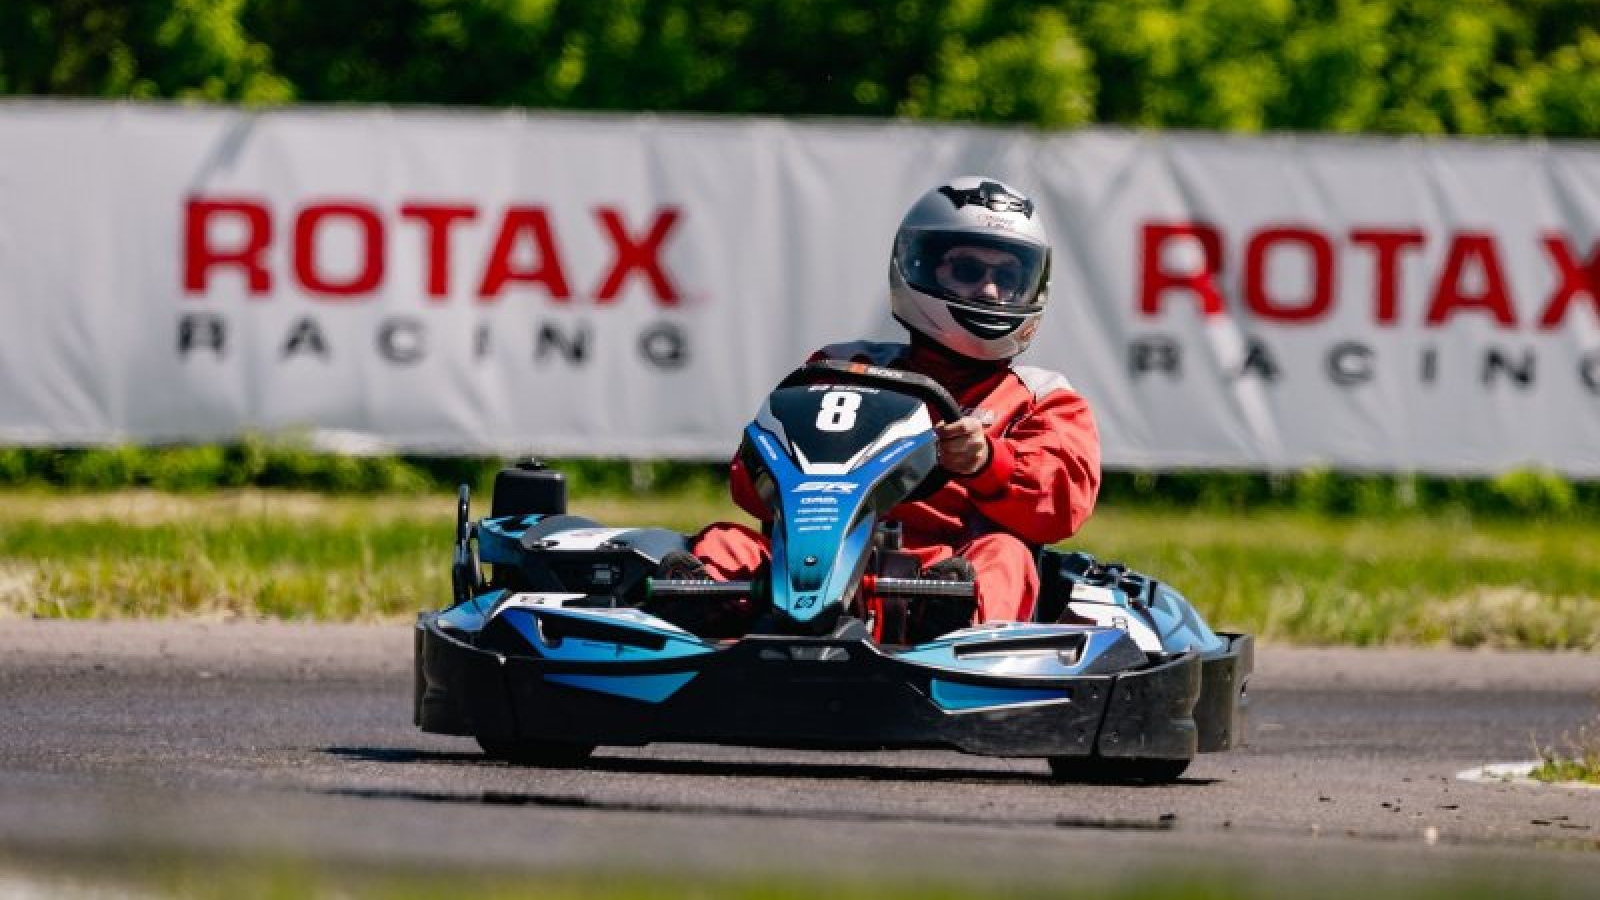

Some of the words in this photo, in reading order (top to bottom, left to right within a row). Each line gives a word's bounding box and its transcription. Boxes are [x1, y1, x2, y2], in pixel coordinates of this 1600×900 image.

[182, 196, 681, 306] ROTAX
[1136, 220, 1600, 330] ROTAX
[177, 314, 689, 369] RACING
[815, 391, 863, 433] 8
